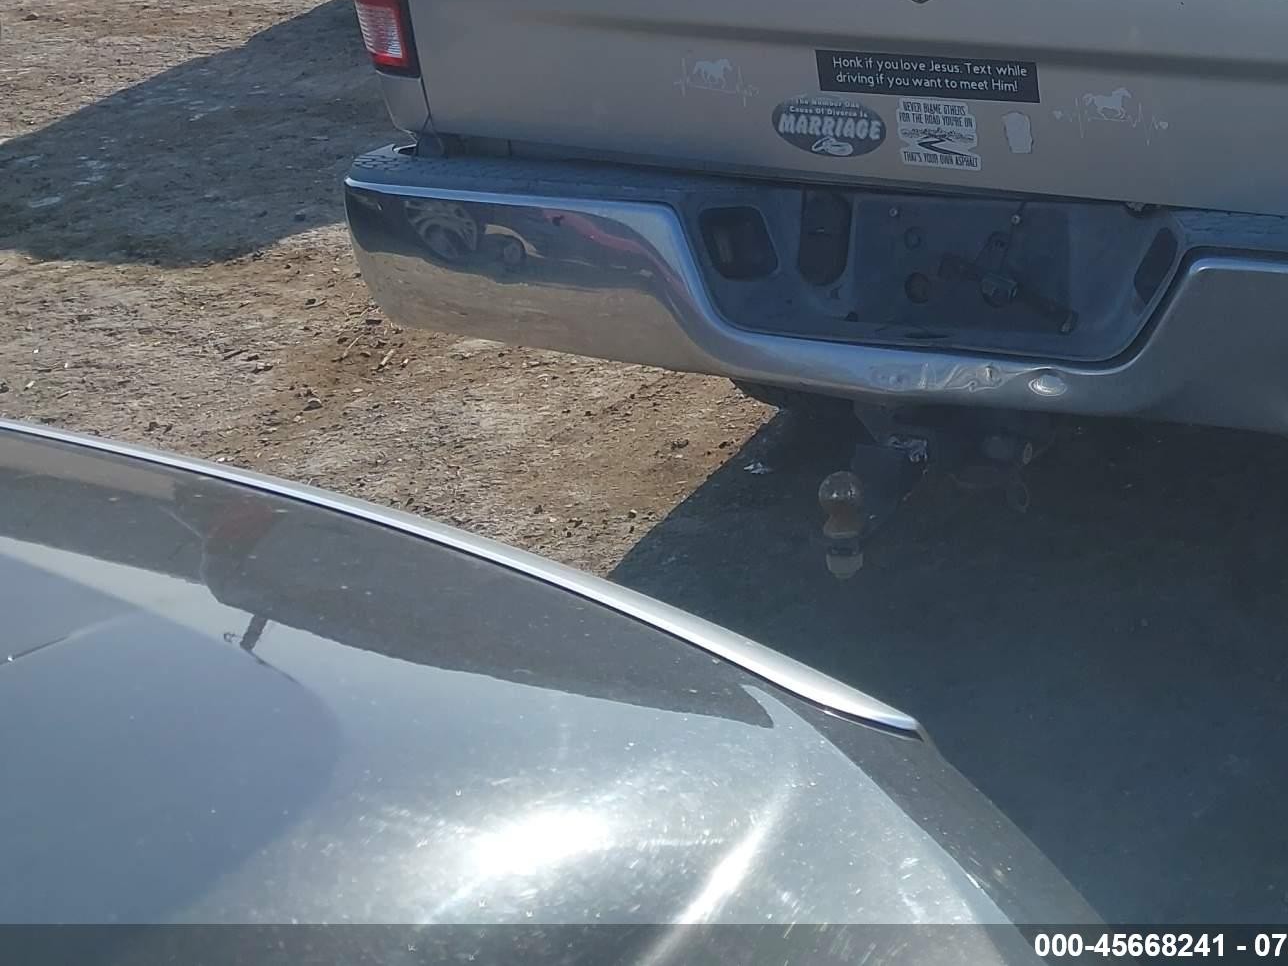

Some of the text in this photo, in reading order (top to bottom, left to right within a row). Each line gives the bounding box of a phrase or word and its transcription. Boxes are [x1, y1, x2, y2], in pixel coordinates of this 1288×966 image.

[832, 56, 1028, 76] Honk if you love Jesus. Text while
[836, 72, 1018, 92] driving if you want to meet Him!
[902, 101, 966, 116] NEVER BLAME OTHERS
[778, 113, 881, 140] MARRIAGE
[899, 112, 973, 128] FOR THE ROAD YOU'RE ON
[903, 151, 978, 168] THAT'S YOUR OWN ASPHALT
